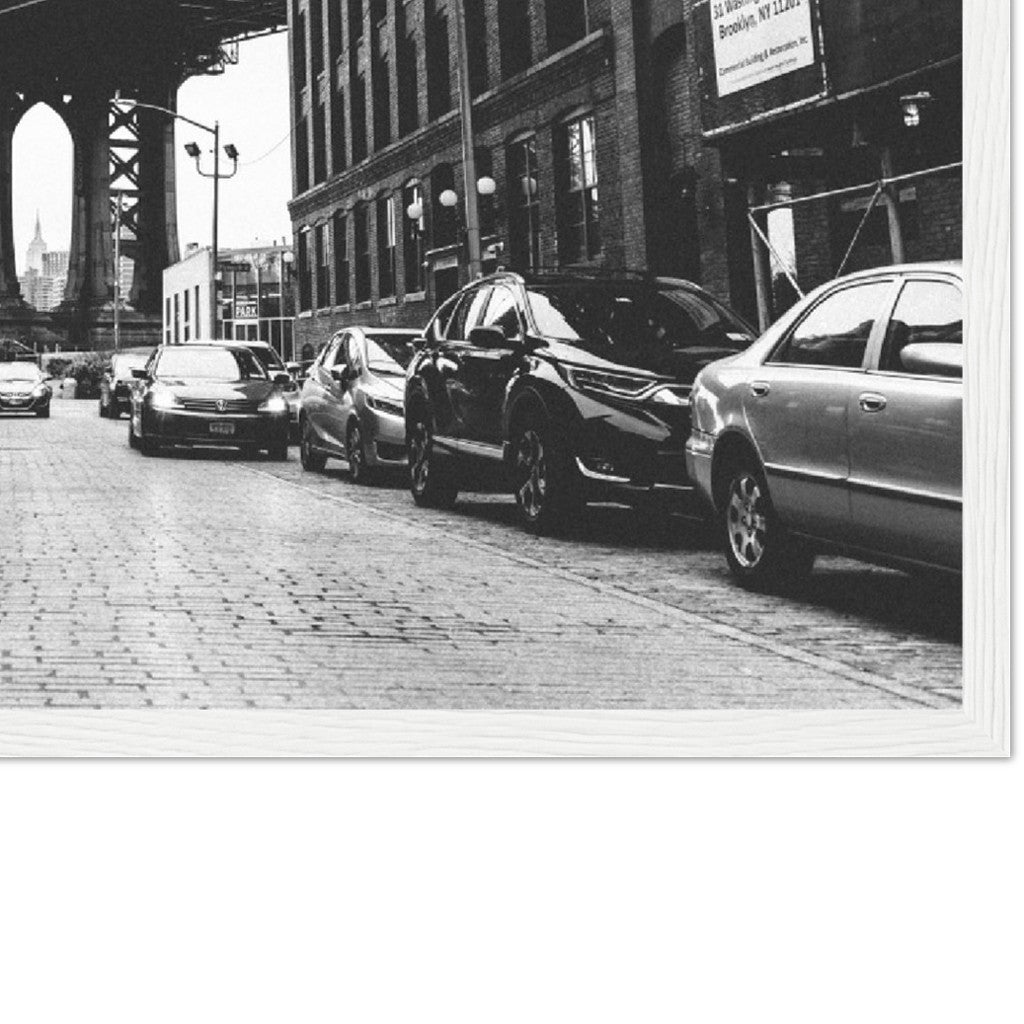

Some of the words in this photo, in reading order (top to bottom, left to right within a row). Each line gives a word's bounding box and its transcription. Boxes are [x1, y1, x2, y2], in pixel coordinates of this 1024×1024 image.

[713, 2, 725, 21] 31
[758, 3, 771, 23] NY
[236, 306, 257, 317] PARK
